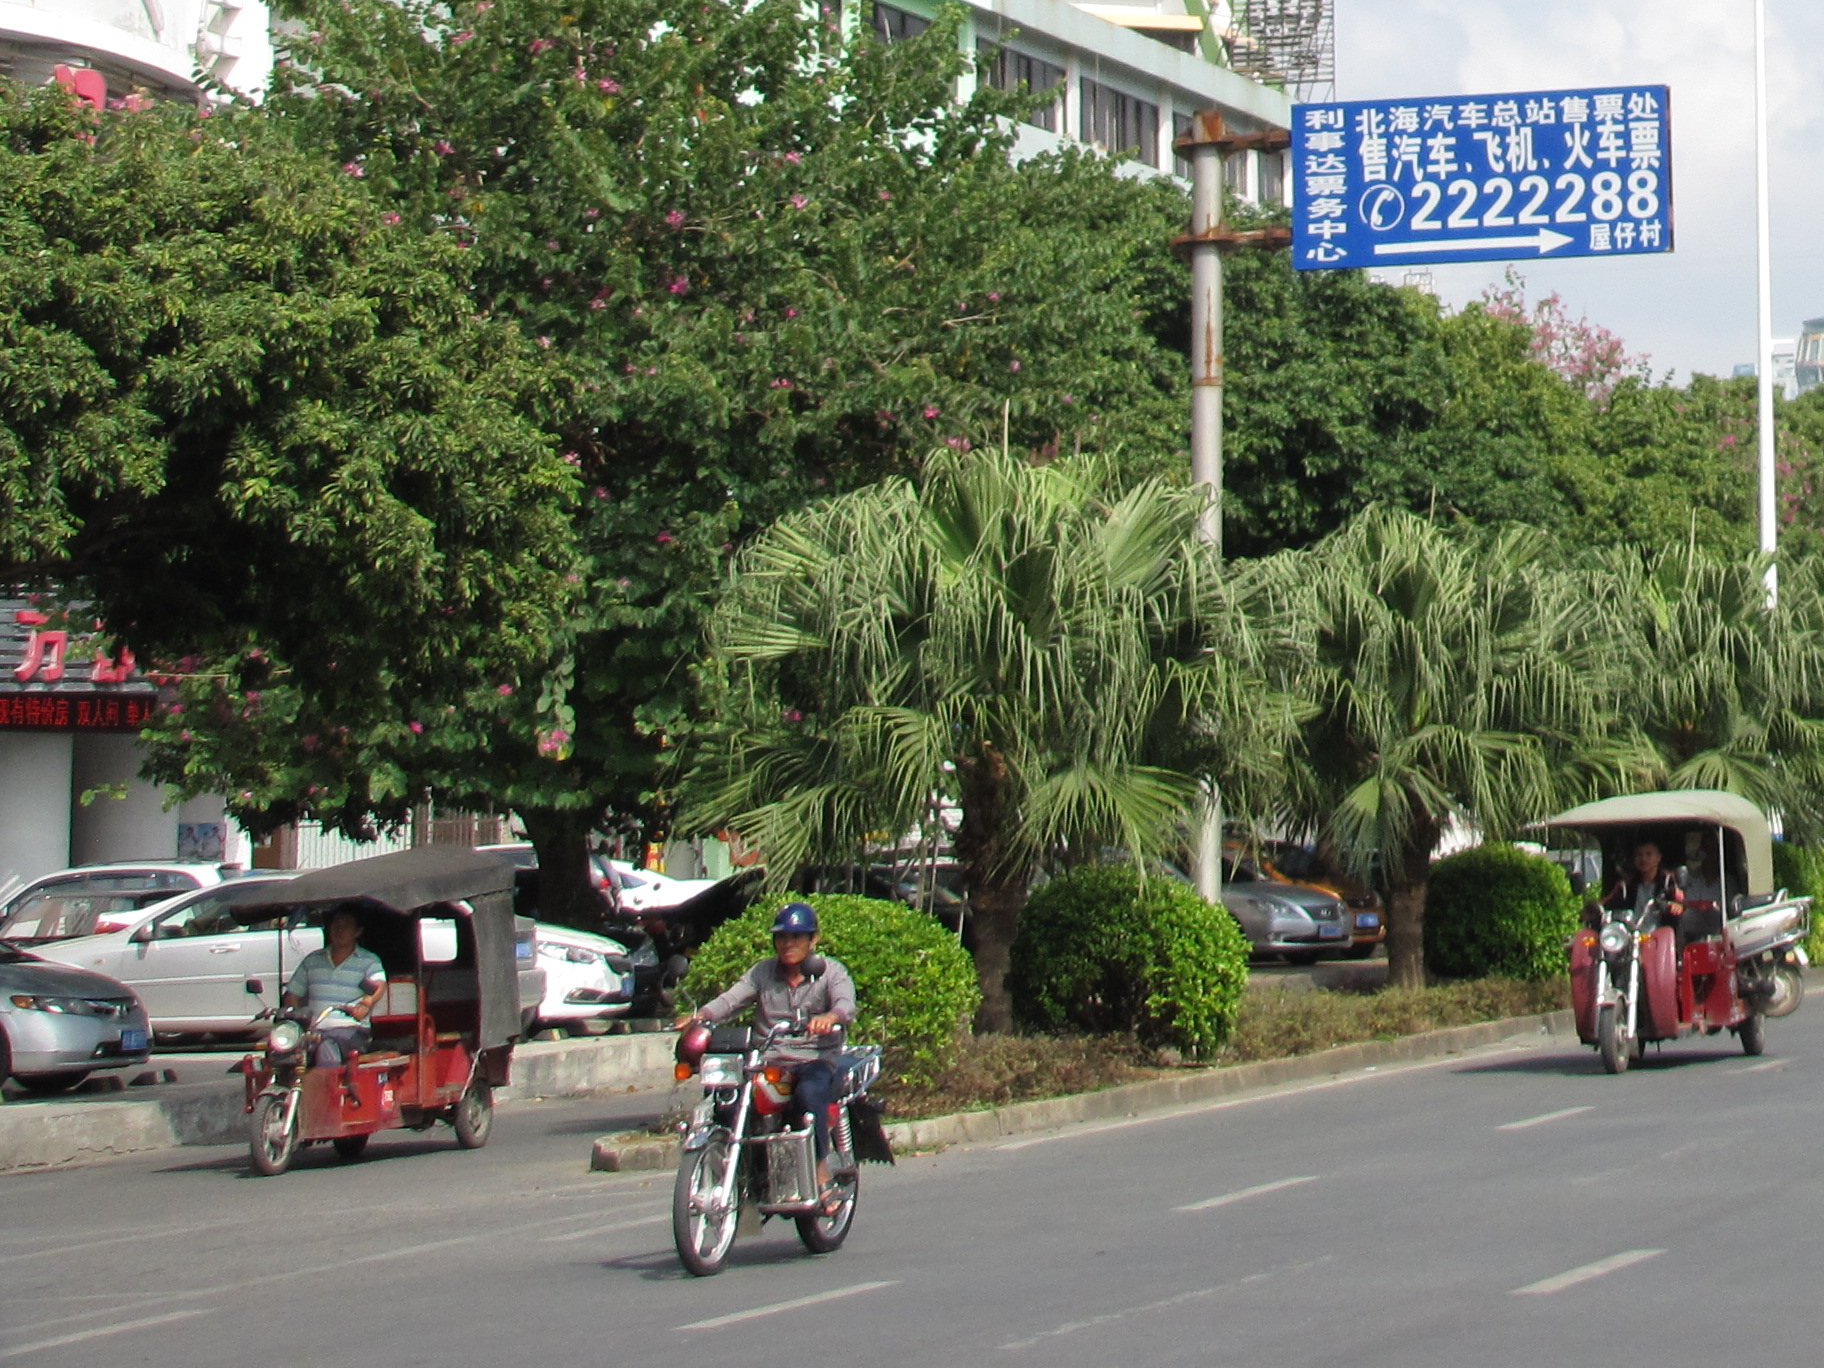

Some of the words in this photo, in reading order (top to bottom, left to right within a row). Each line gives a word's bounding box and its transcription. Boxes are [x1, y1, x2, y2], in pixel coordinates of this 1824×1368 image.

[1355, 92, 1660, 134] 北海汽车总站售票处
[1305, 108, 1348, 262] 利事达票务中心
[1410, 169, 1660, 231] 2222288
[1589, 220, 1662, 250] 屋仔村
